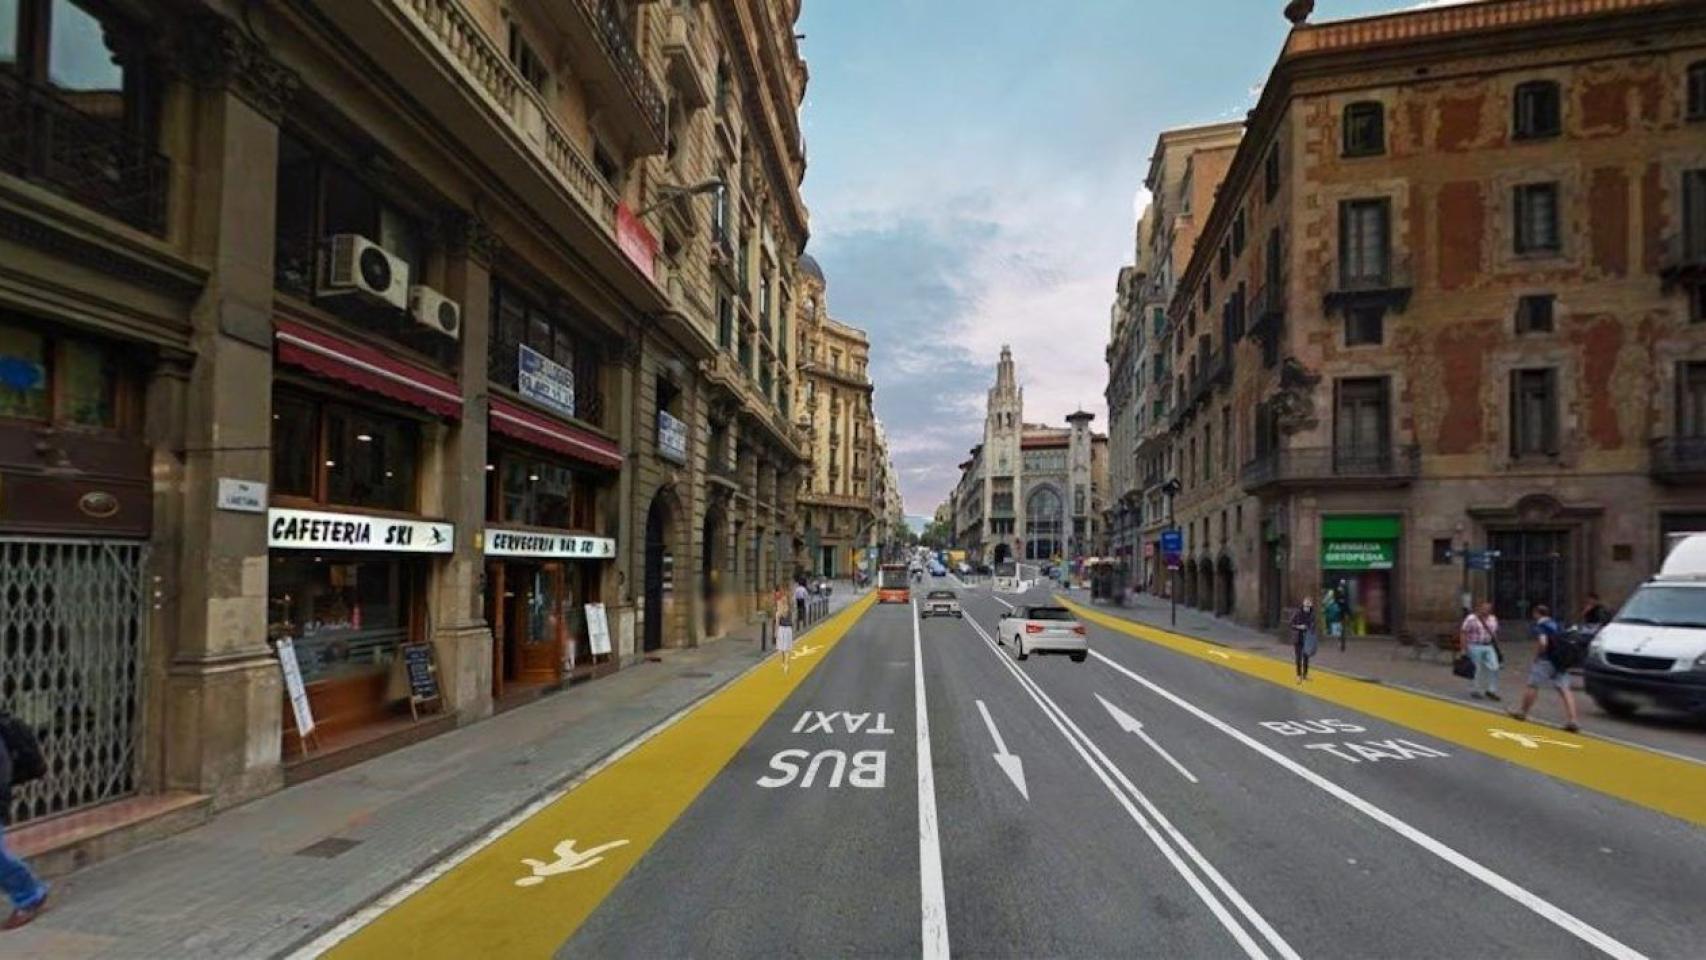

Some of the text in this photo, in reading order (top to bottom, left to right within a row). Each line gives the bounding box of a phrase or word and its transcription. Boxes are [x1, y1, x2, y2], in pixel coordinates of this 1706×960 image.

[272, 517, 413, 545] CAFETERIA SKI
[493, 533, 595, 554] CERVECERIA BAR SKI
[791, 711, 895, 734] TAXI
[1258, 718, 1367, 736] BUS
[1304, 738, 1451, 762] TAXI
[756, 749, 886, 788] BUS
